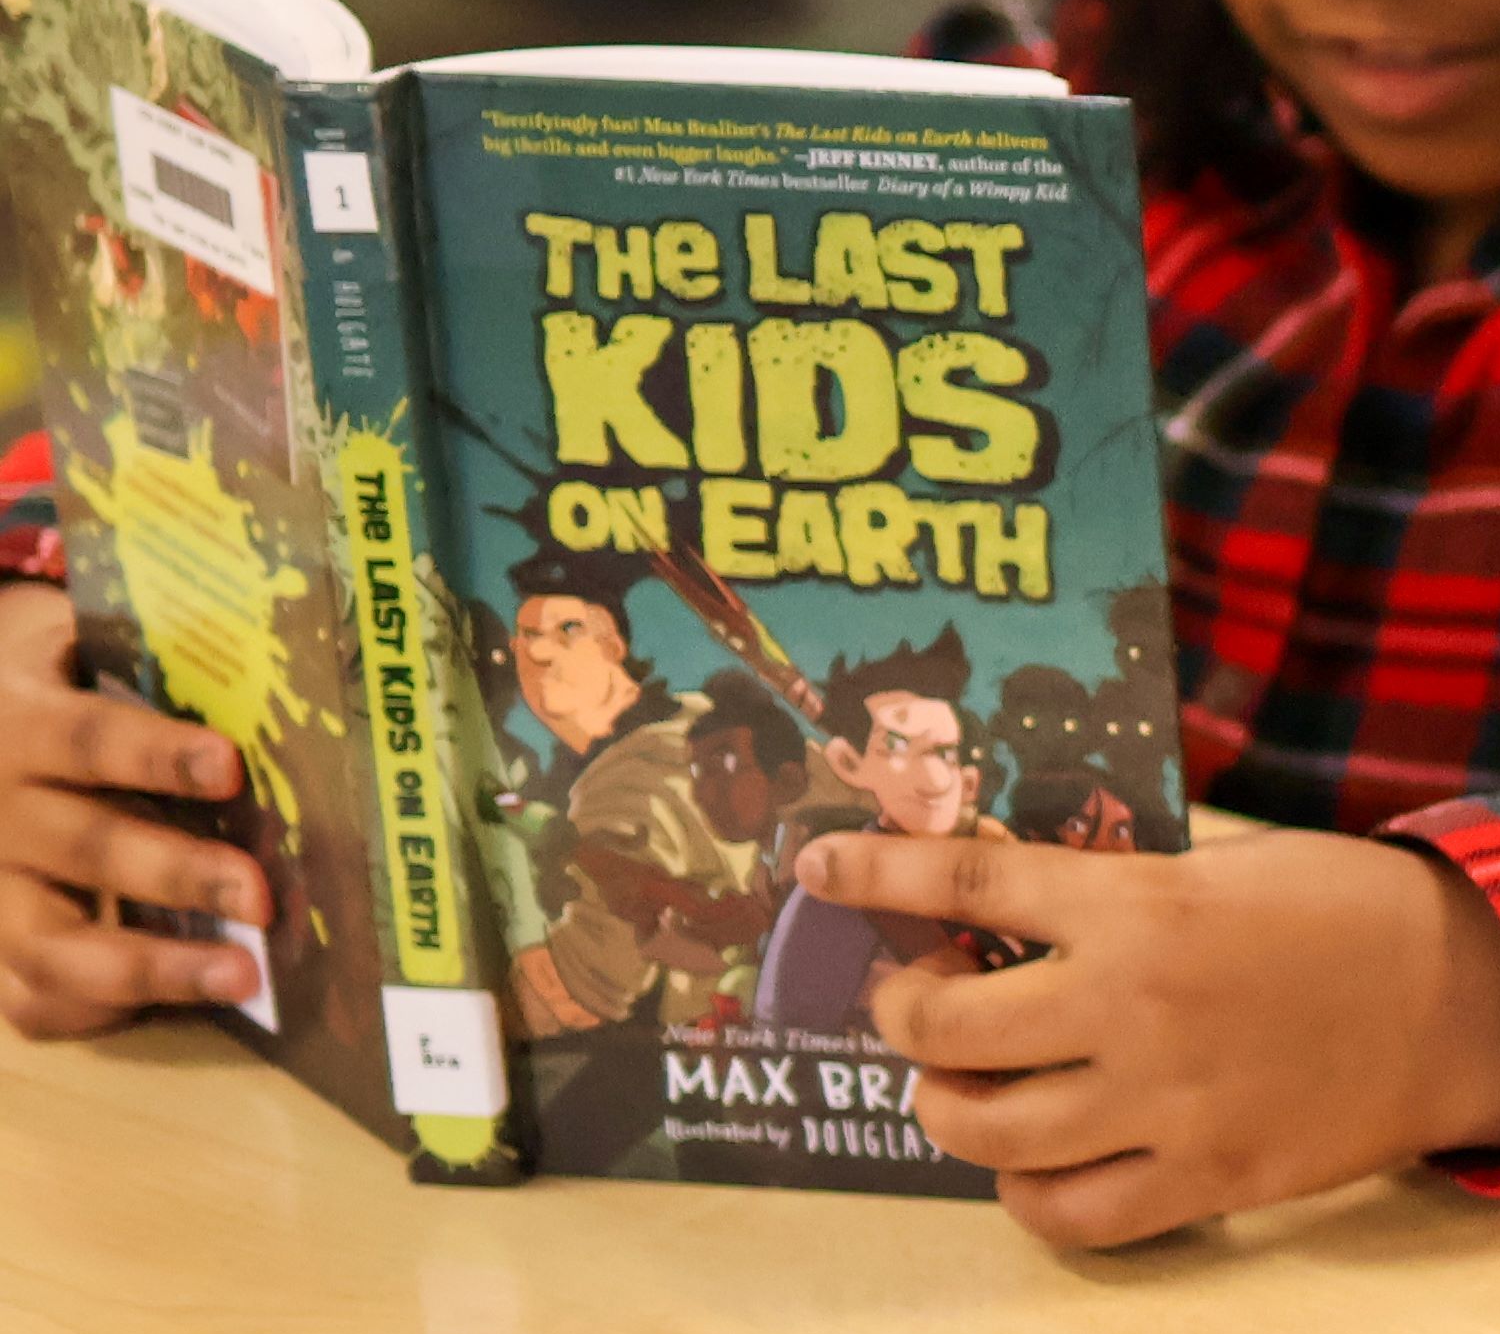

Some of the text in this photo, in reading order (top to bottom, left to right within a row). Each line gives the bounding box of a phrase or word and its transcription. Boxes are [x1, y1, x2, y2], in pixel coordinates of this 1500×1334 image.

[745, 213, 1023, 317] LAST
[543, 312, 1039, 484] KIDS
[548, 479, 1052, 600] ON EARTH
[366, 558, 406, 651] LAST
[379, 664, 422, 754] KIDS
[395, 770, 425, 819] ON
[398, 836, 440, 950] EARTH
[665, 1051, 798, 1107] MAX
